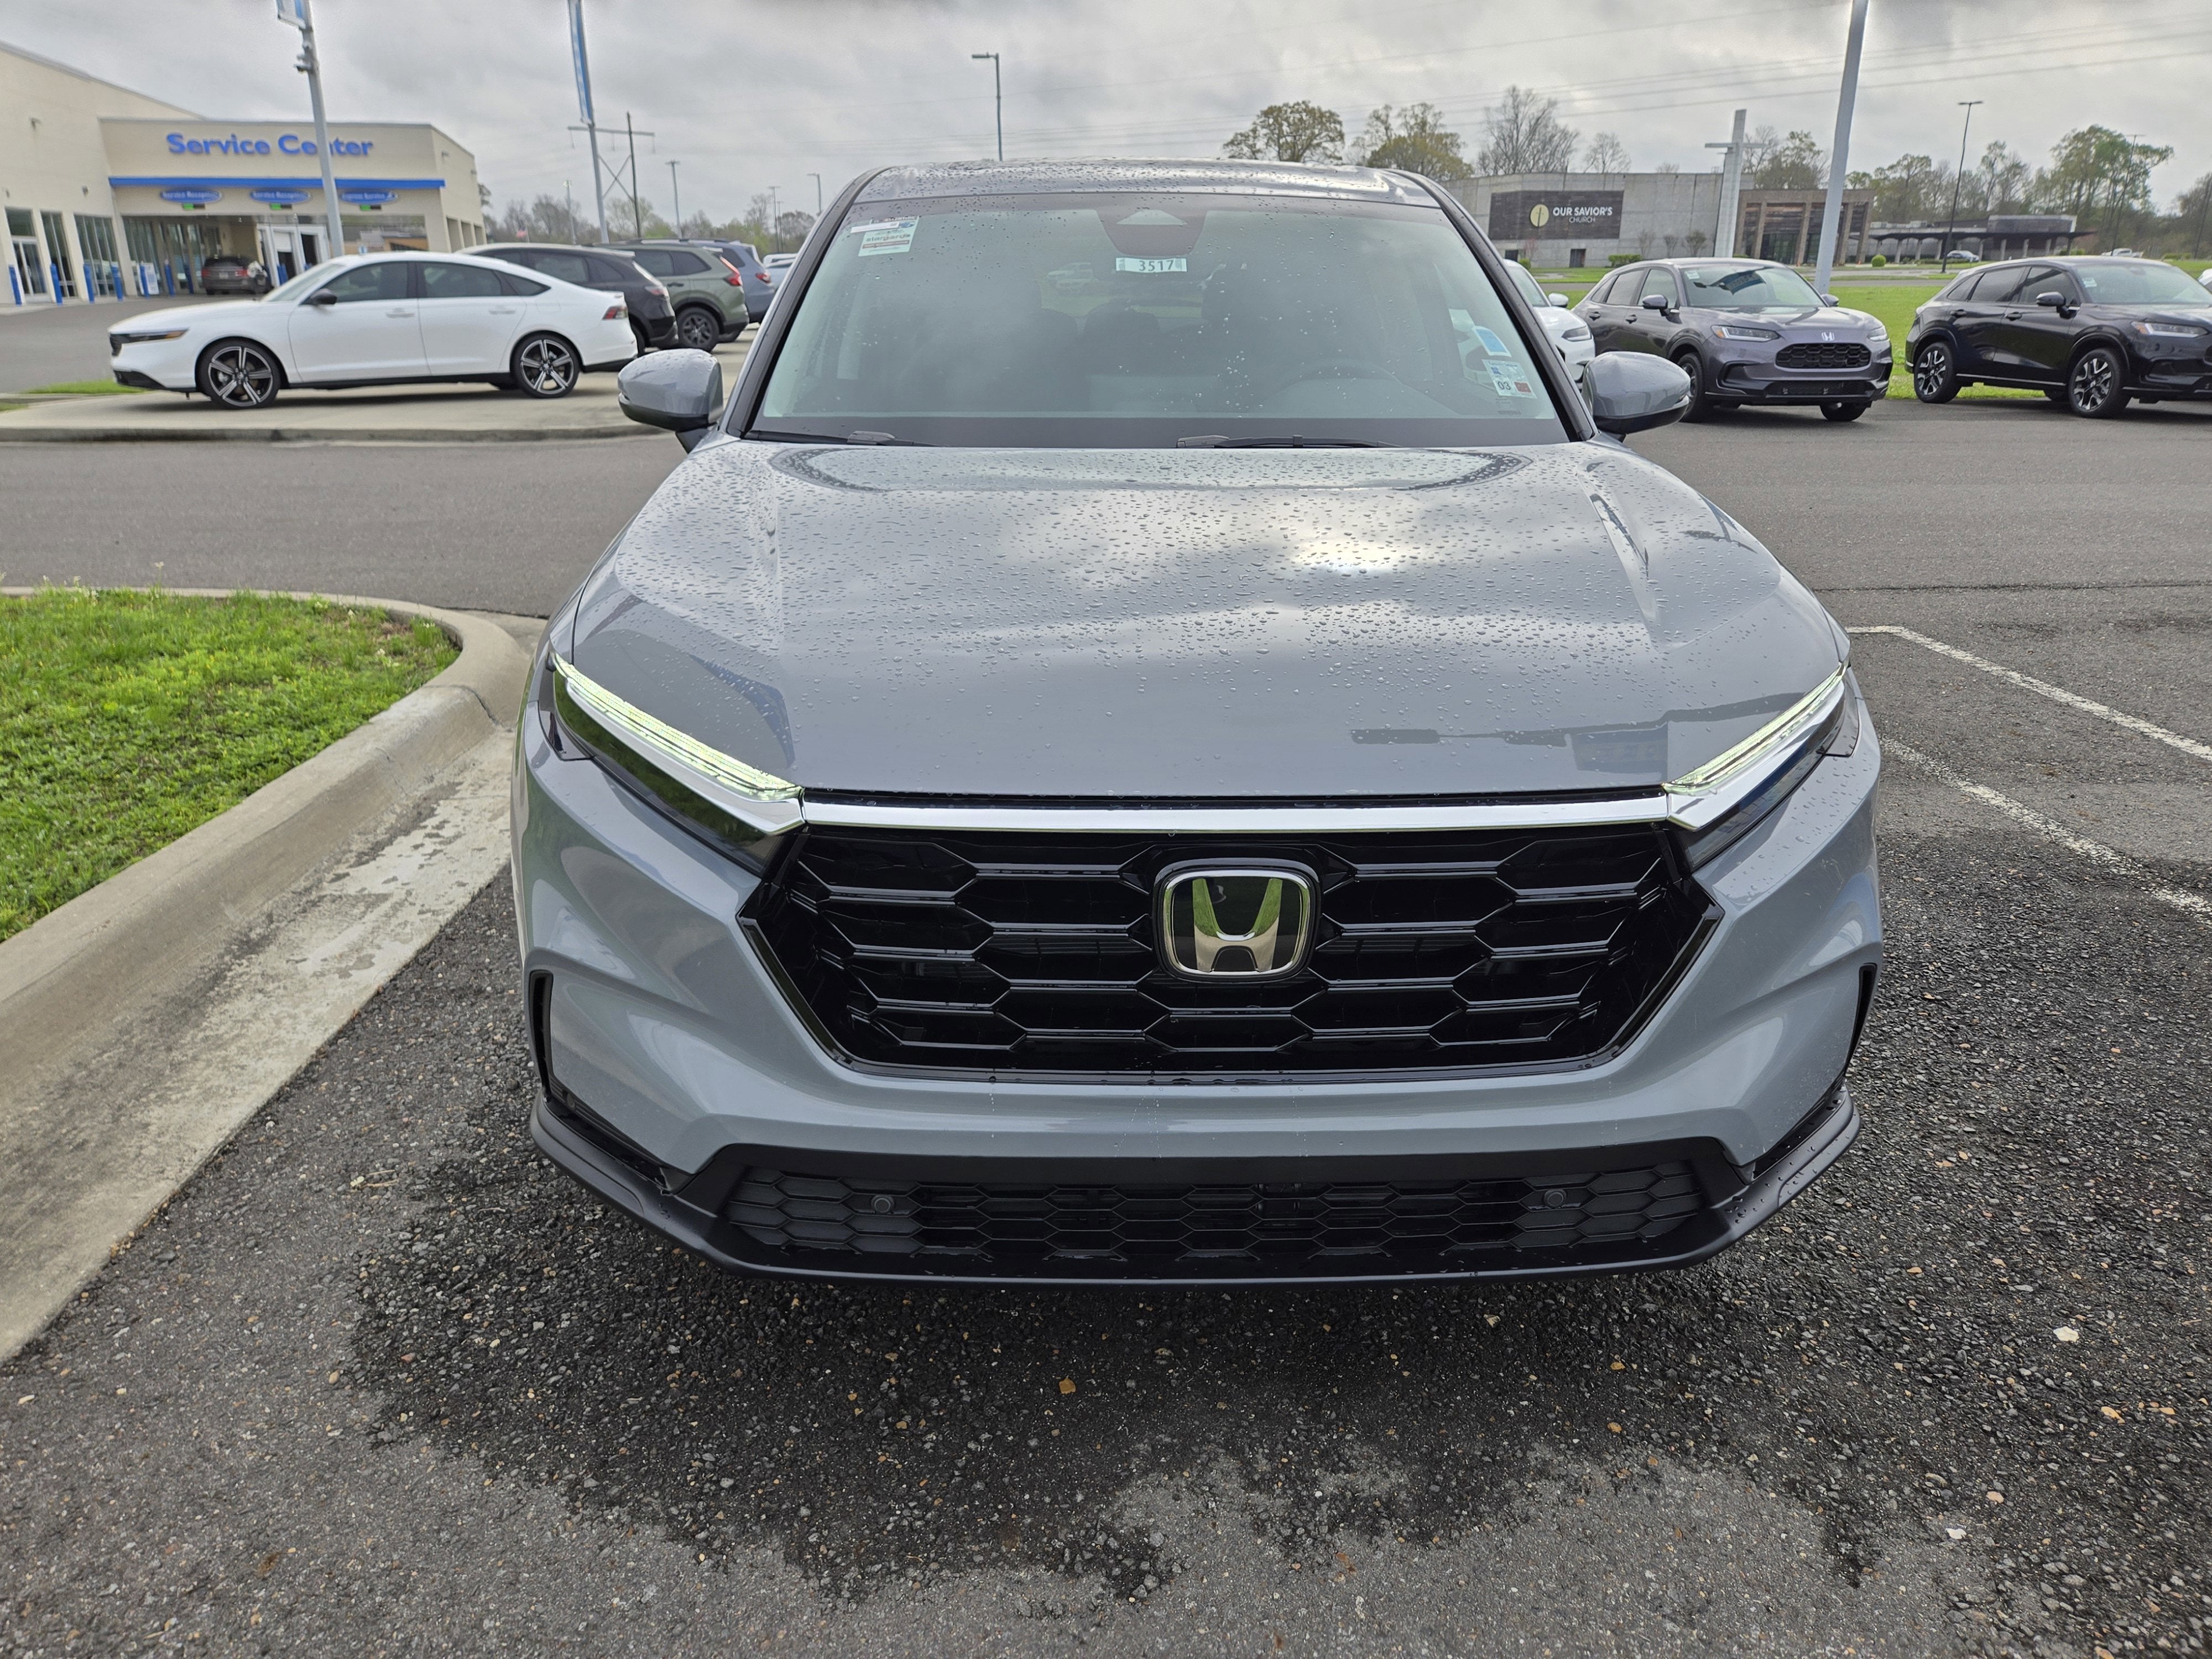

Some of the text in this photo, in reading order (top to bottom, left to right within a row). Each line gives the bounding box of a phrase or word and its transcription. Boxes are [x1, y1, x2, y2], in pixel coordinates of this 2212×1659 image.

[166, 132, 374, 156] Service Ceter
[1553, 207, 1612, 216] OUR SAVIOR'S
[1139, 260, 1173, 272] 3517
[1498, 381, 1511, 390] 03
